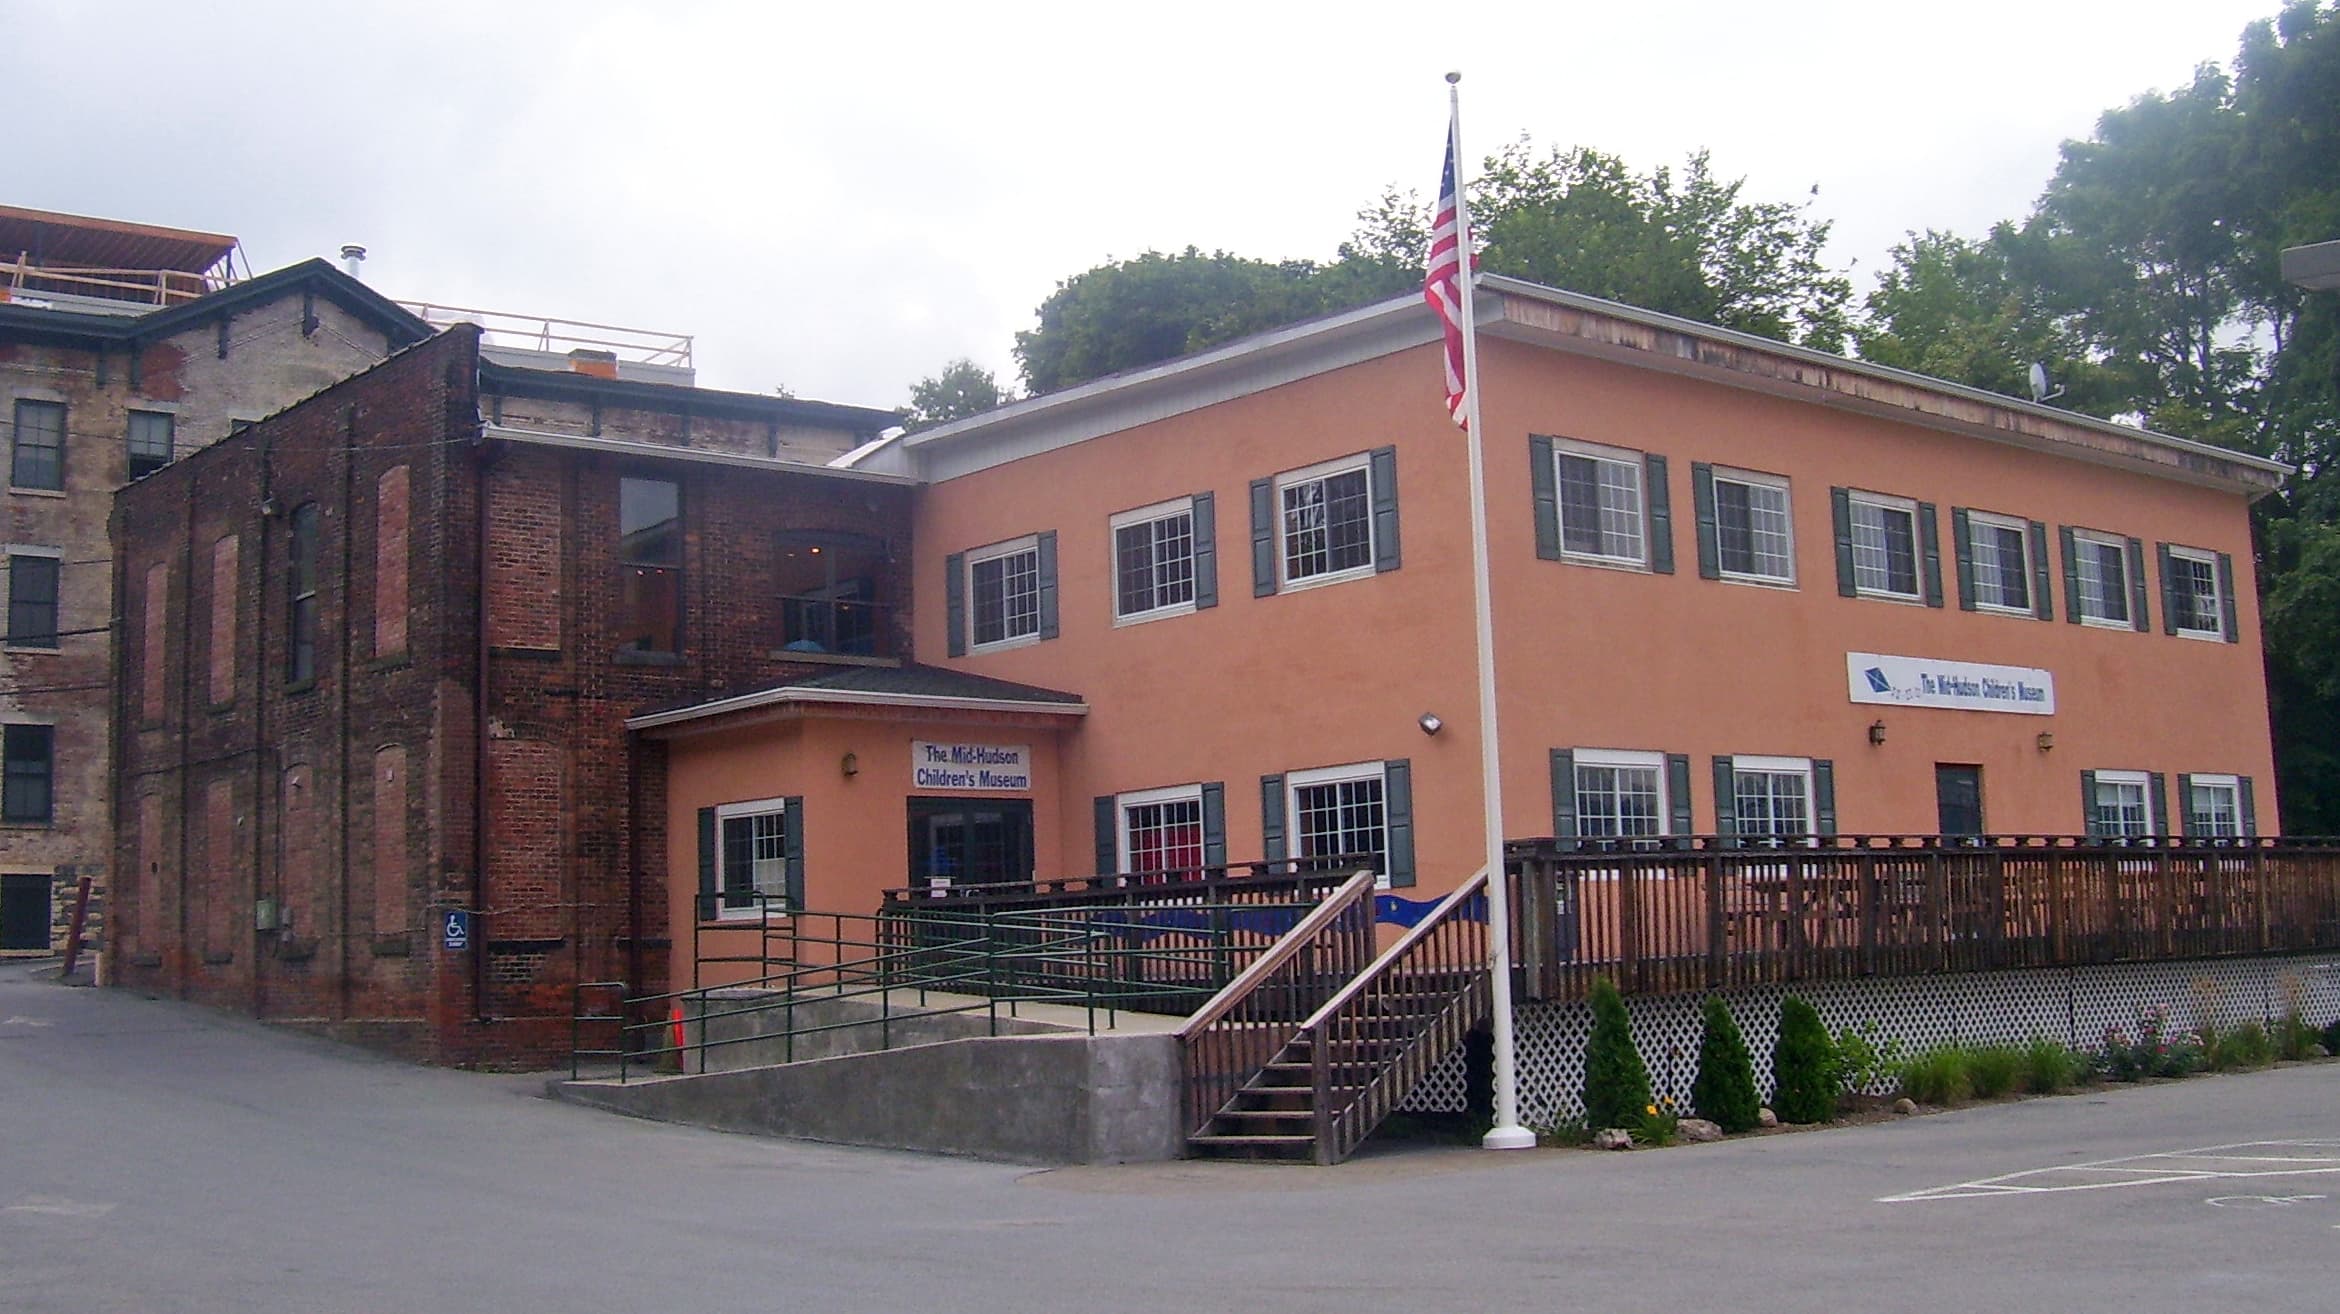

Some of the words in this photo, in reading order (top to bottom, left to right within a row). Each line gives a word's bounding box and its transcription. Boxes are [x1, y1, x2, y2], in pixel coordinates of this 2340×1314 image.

[1921, 673, 1935, 694] The
[2017, 681, 2045, 702] Museum
[925, 745, 948, 762] The
[951, 746, 1018, 765] Mid-Hudson
[917, 768, 976, 787] Children's
[979, 770, 1027, 788] Museum
